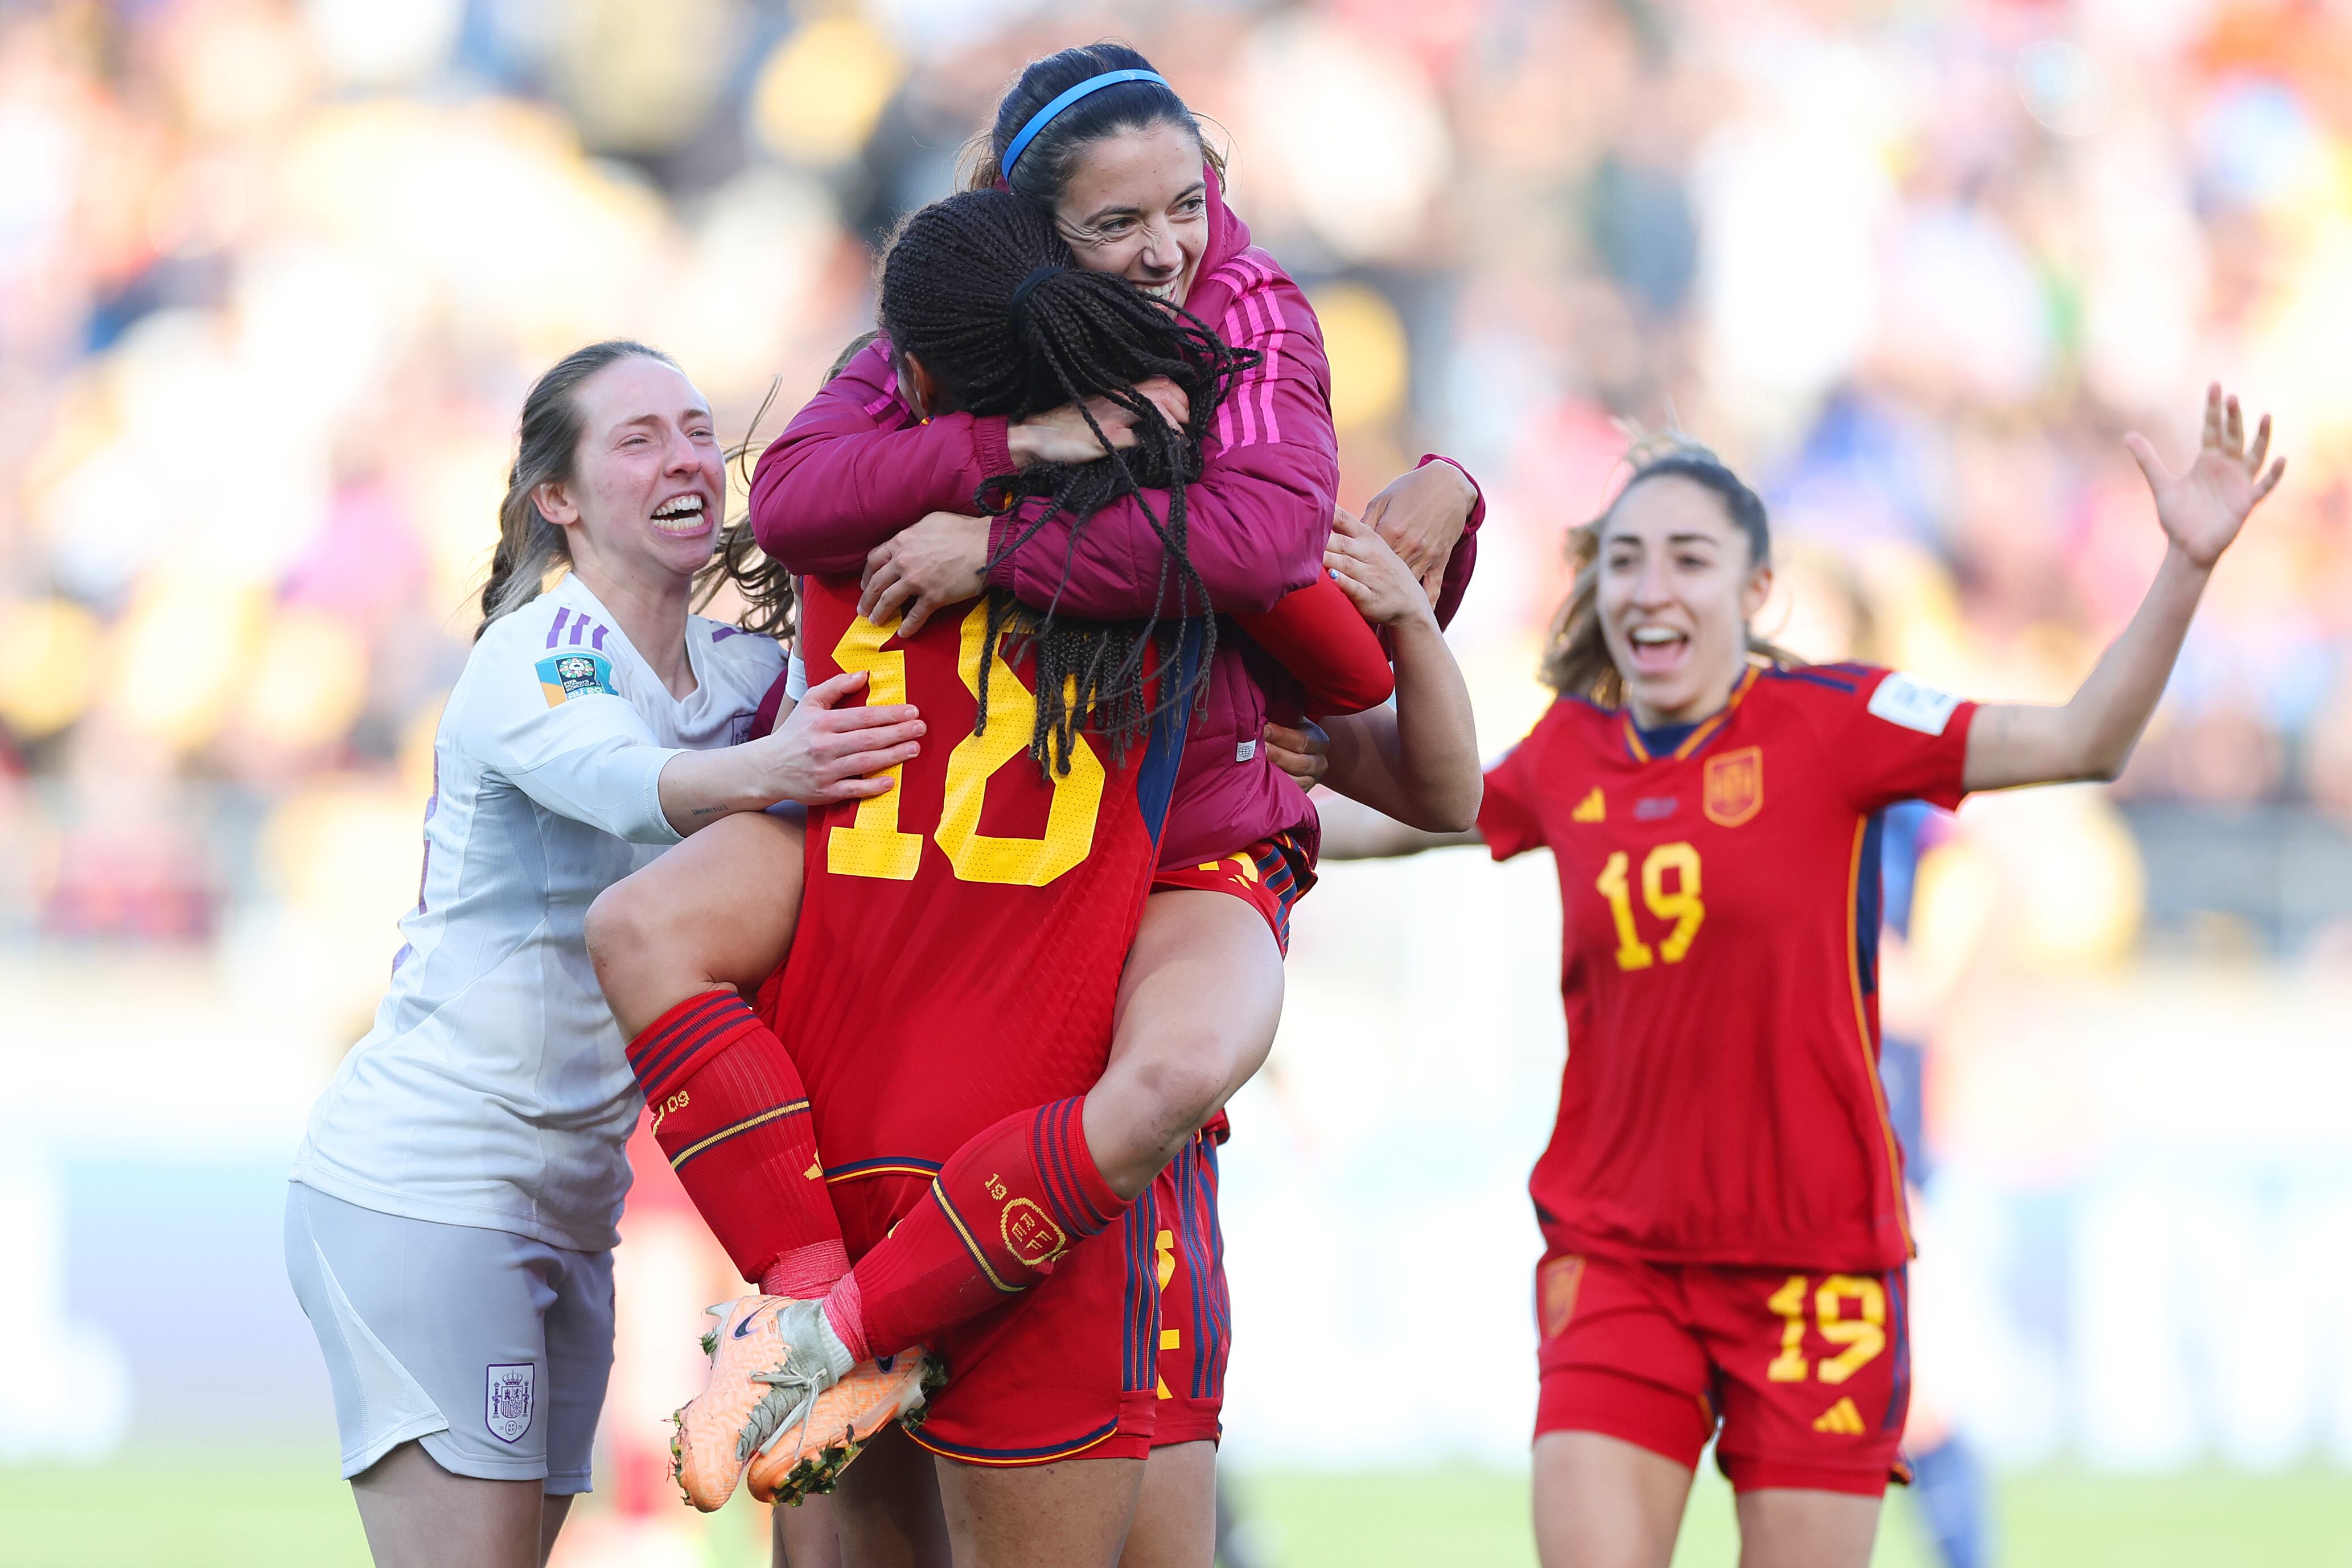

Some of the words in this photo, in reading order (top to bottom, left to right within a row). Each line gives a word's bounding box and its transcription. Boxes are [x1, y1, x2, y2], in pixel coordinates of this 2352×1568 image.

[828, 598, 1105, 887] 18
[1596, 842, 1705, 971] 19
[667, 1090, 690, 1113] 09
[984, 1173, 1007, 1201] 19
[1767, 1274, 1886, 1384] 19
